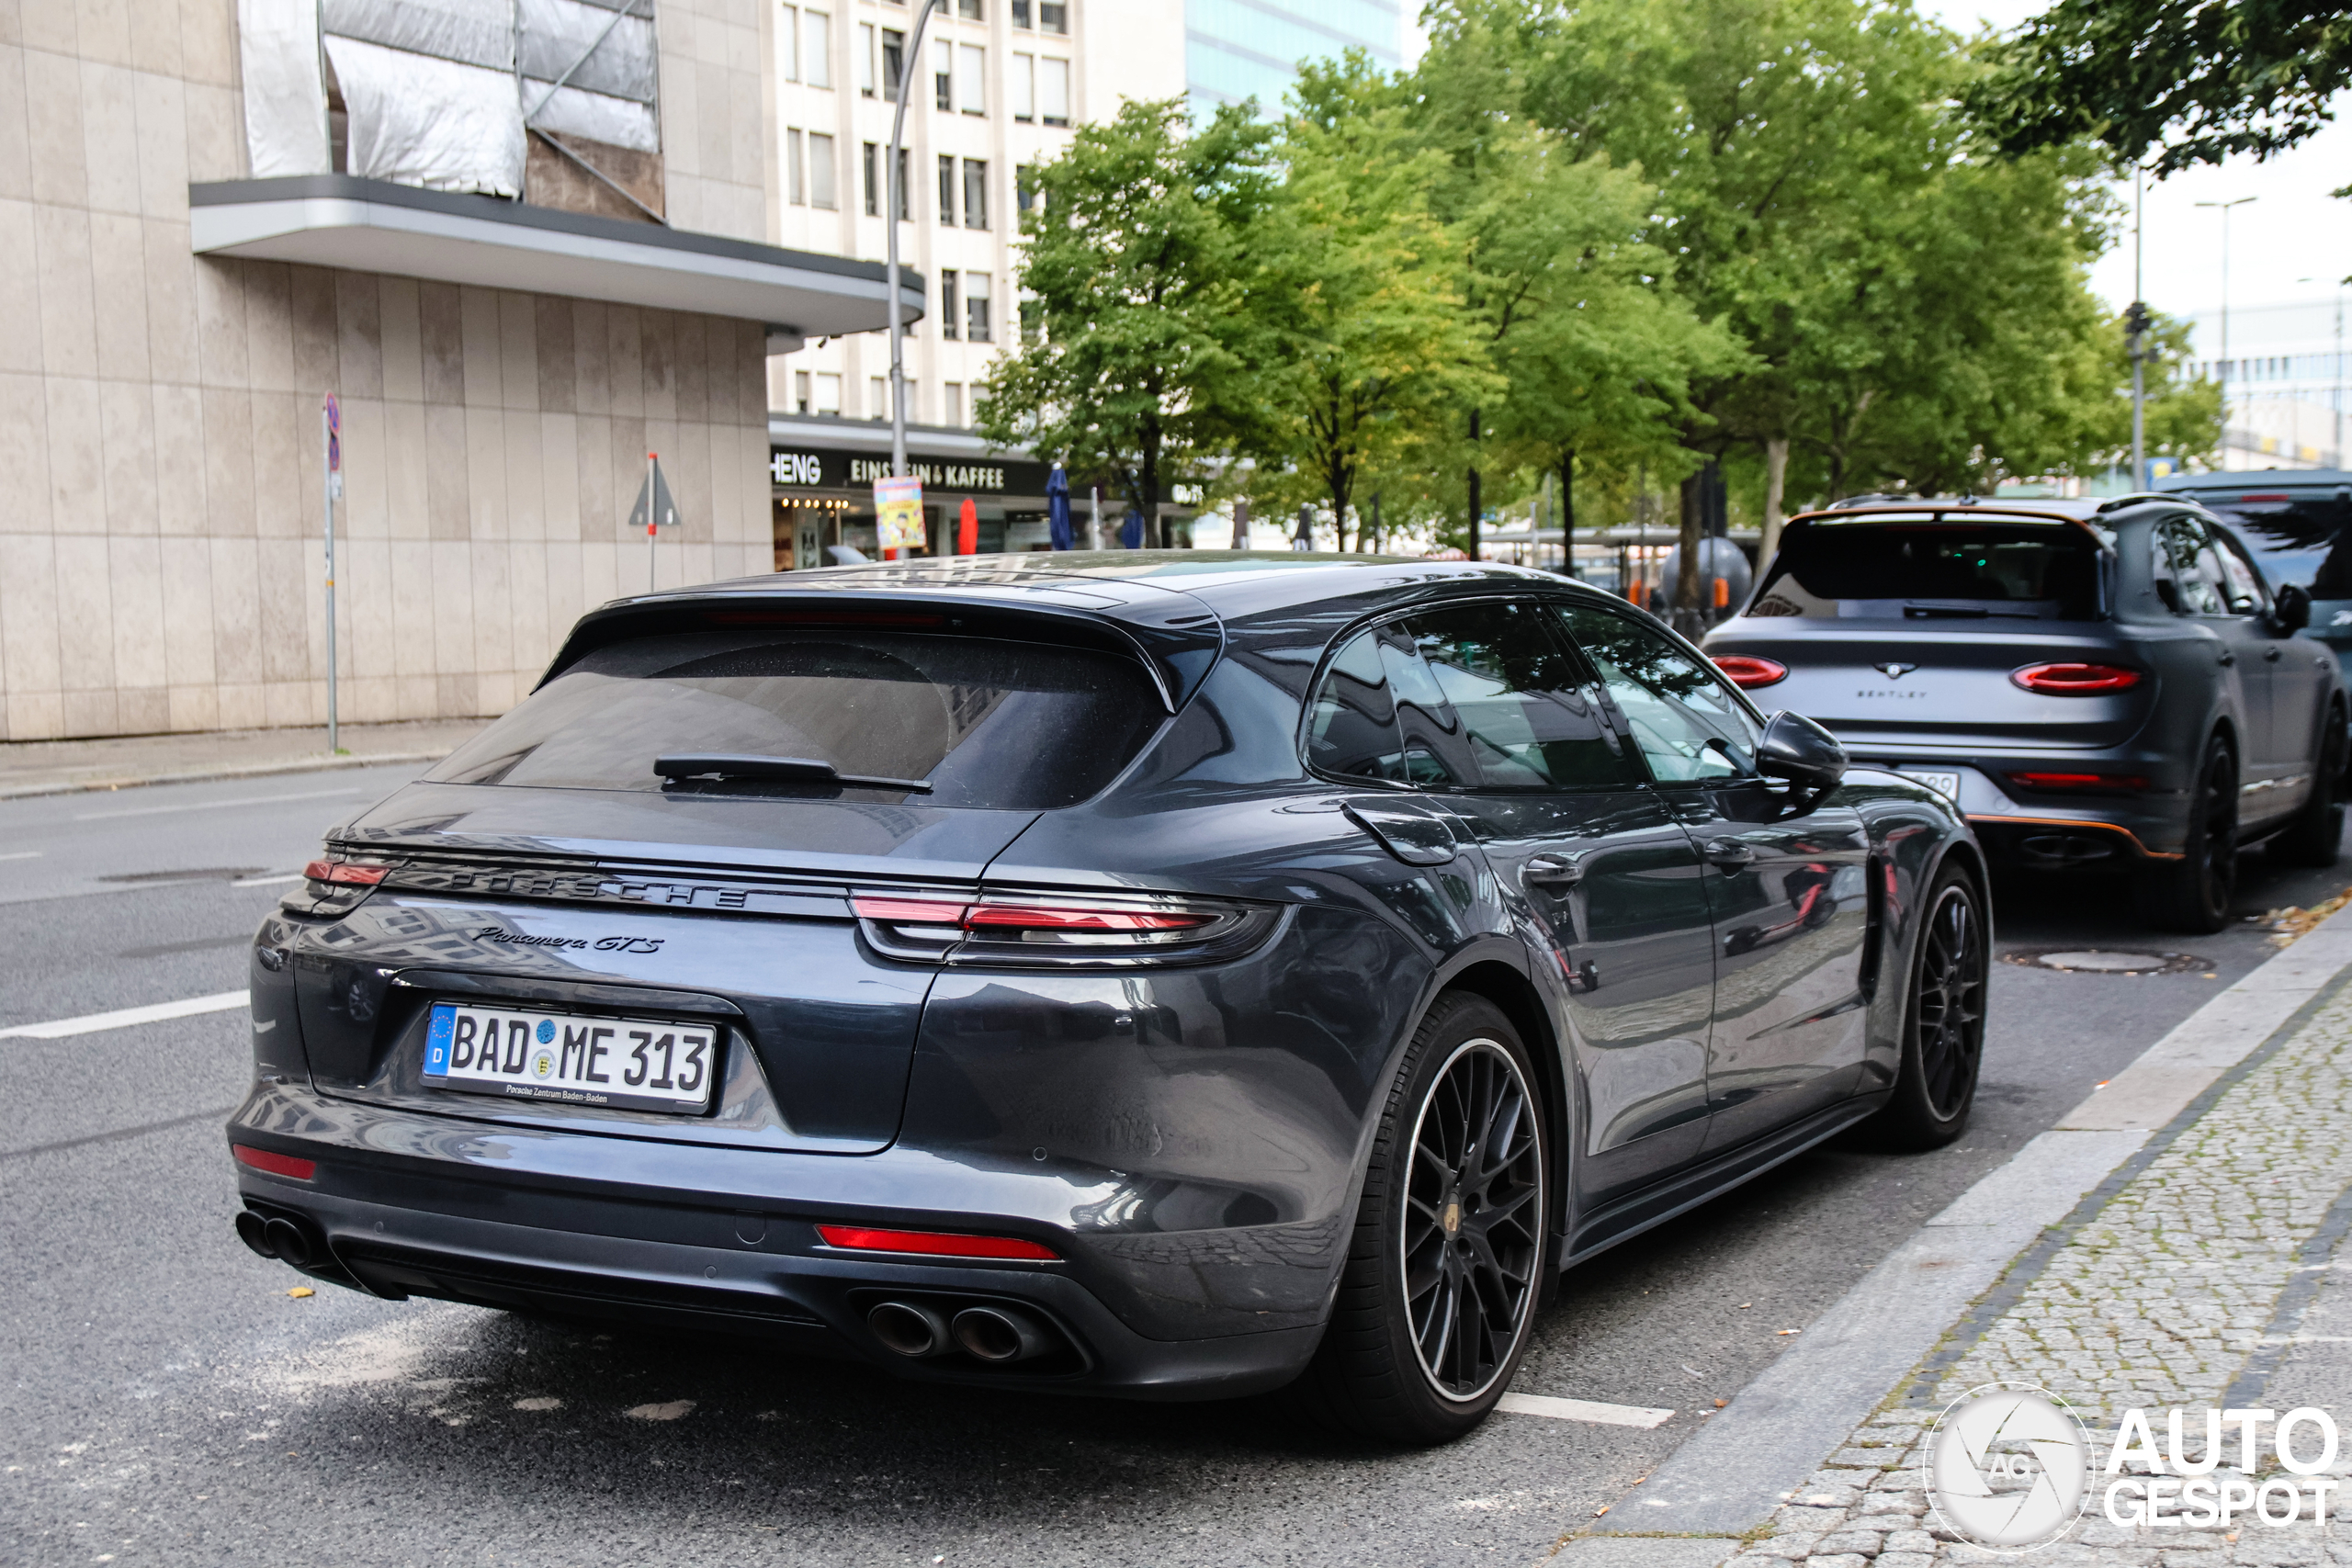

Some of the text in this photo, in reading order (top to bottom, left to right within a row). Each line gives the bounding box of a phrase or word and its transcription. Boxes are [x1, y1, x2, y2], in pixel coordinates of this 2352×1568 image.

[851, 459, 1004, 489] EINSIN KAFFEE
[1857, 690, 1928, 698] BENTLEY
[451, 873, 747, 908] PORSCHE
[472, 927, 665, 953] Panamera GTS
[433, 1048, 443, 1063] D
[451, 1015, 530, 1074] BAD
[560, 1024, 615, 1083] ME
[624, 1031, 707, 1090] 313
[506, 1084, 607, 1103] Porsche Zentrum Baden-Baden
